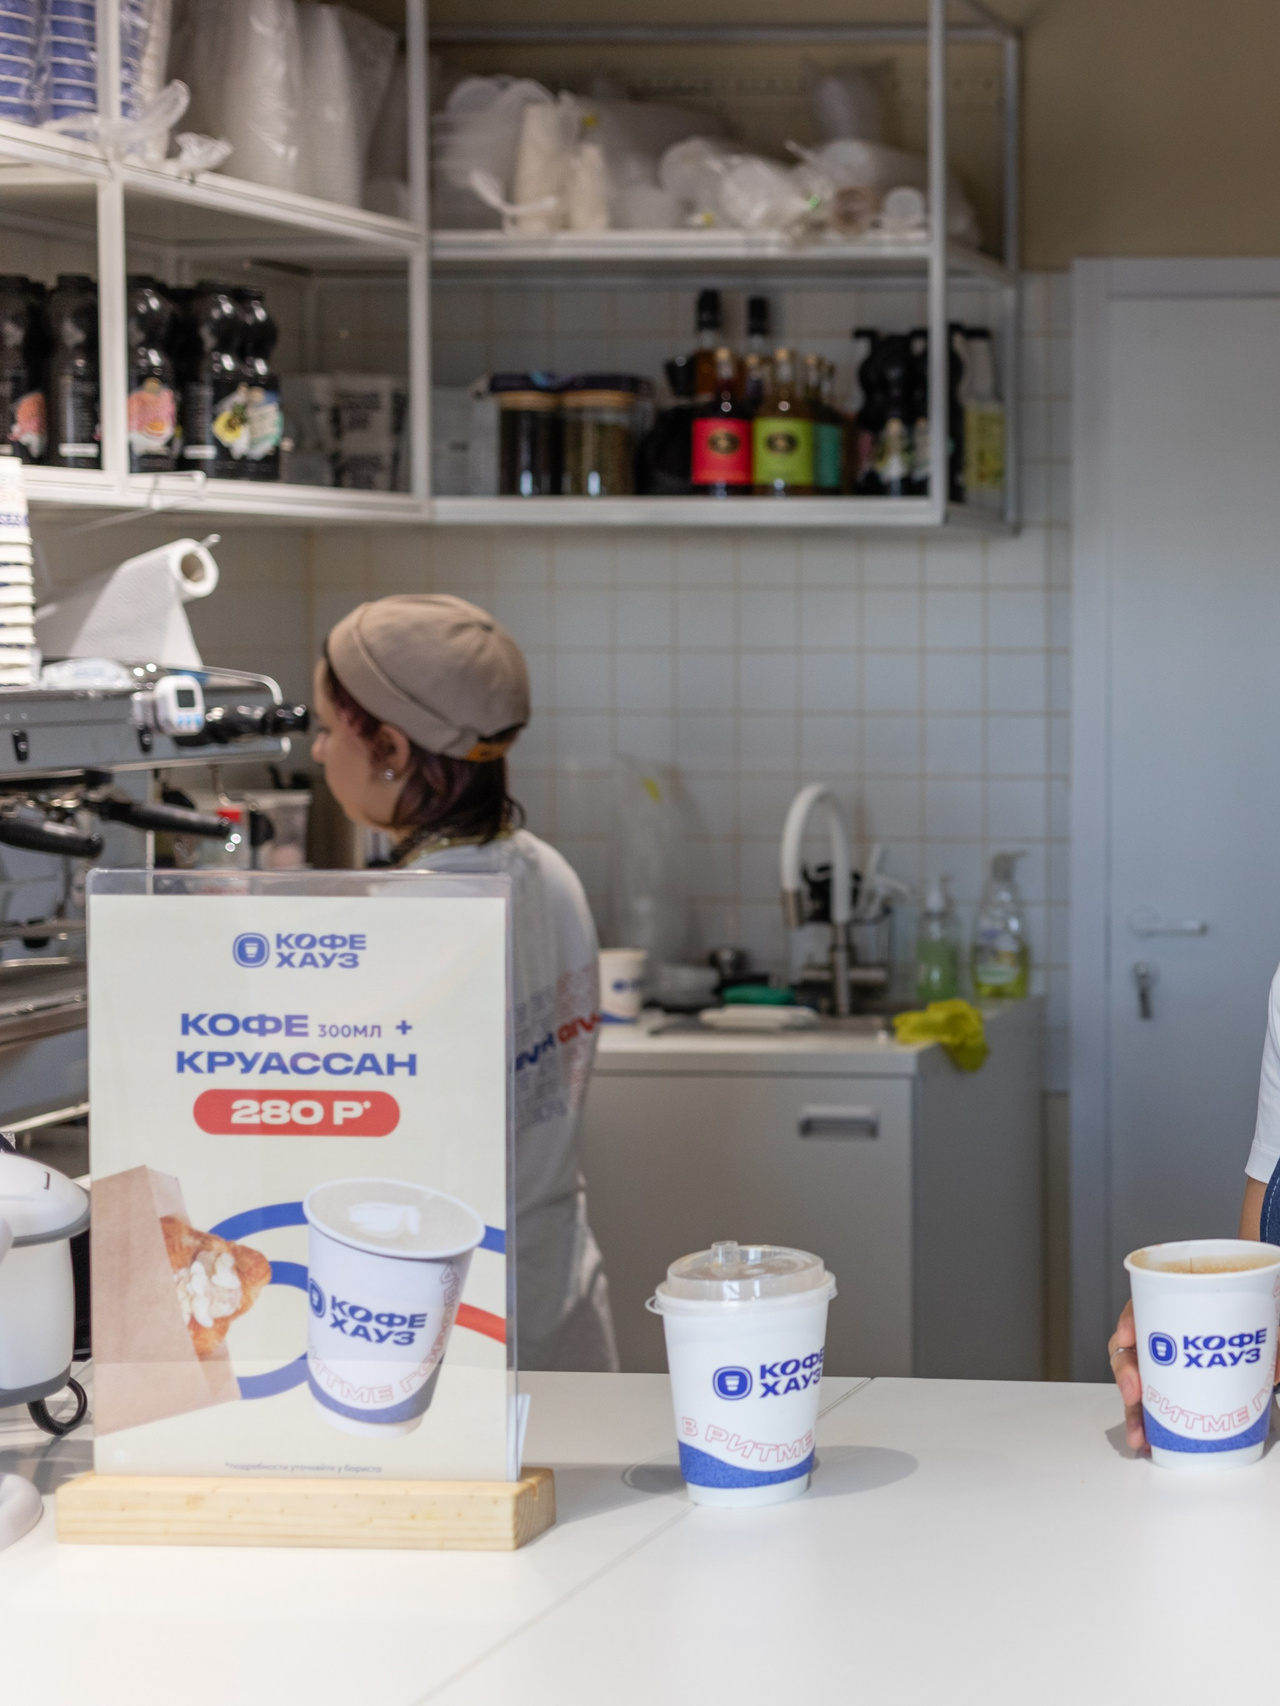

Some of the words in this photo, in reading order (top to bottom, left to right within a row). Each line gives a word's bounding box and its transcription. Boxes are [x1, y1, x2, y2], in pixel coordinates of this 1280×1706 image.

[276, 933, 366, 950] КОФЕ
[276, 951, 360, 969] ХАУЗ
[180, 1013, 310, 1038] КОФЕ
[317, 1024, 383, 1039] 300МЛ
[176, 1051, 418, 1077] КРУАССАН
[230, 1099, 324, 1126] 280
[330, 1294, 428, 1329] КОФЕ
[329, 1312, 416, 1346] ХАУЗ
[1183, 1328, 1268, 1351] КОФЕ
[1183, 1348, 1262, 1369] ХАУЗ
[308, 1347, 394, 1404] ИТМЕ
[759, 1366, 822, 1399] ХАУЗ
[1146, 1384, 1250, 1433] РИТМЕ
[681, 1416, 699, 1438] В
[704, 1424, 815, 1463] РИТМЕ
